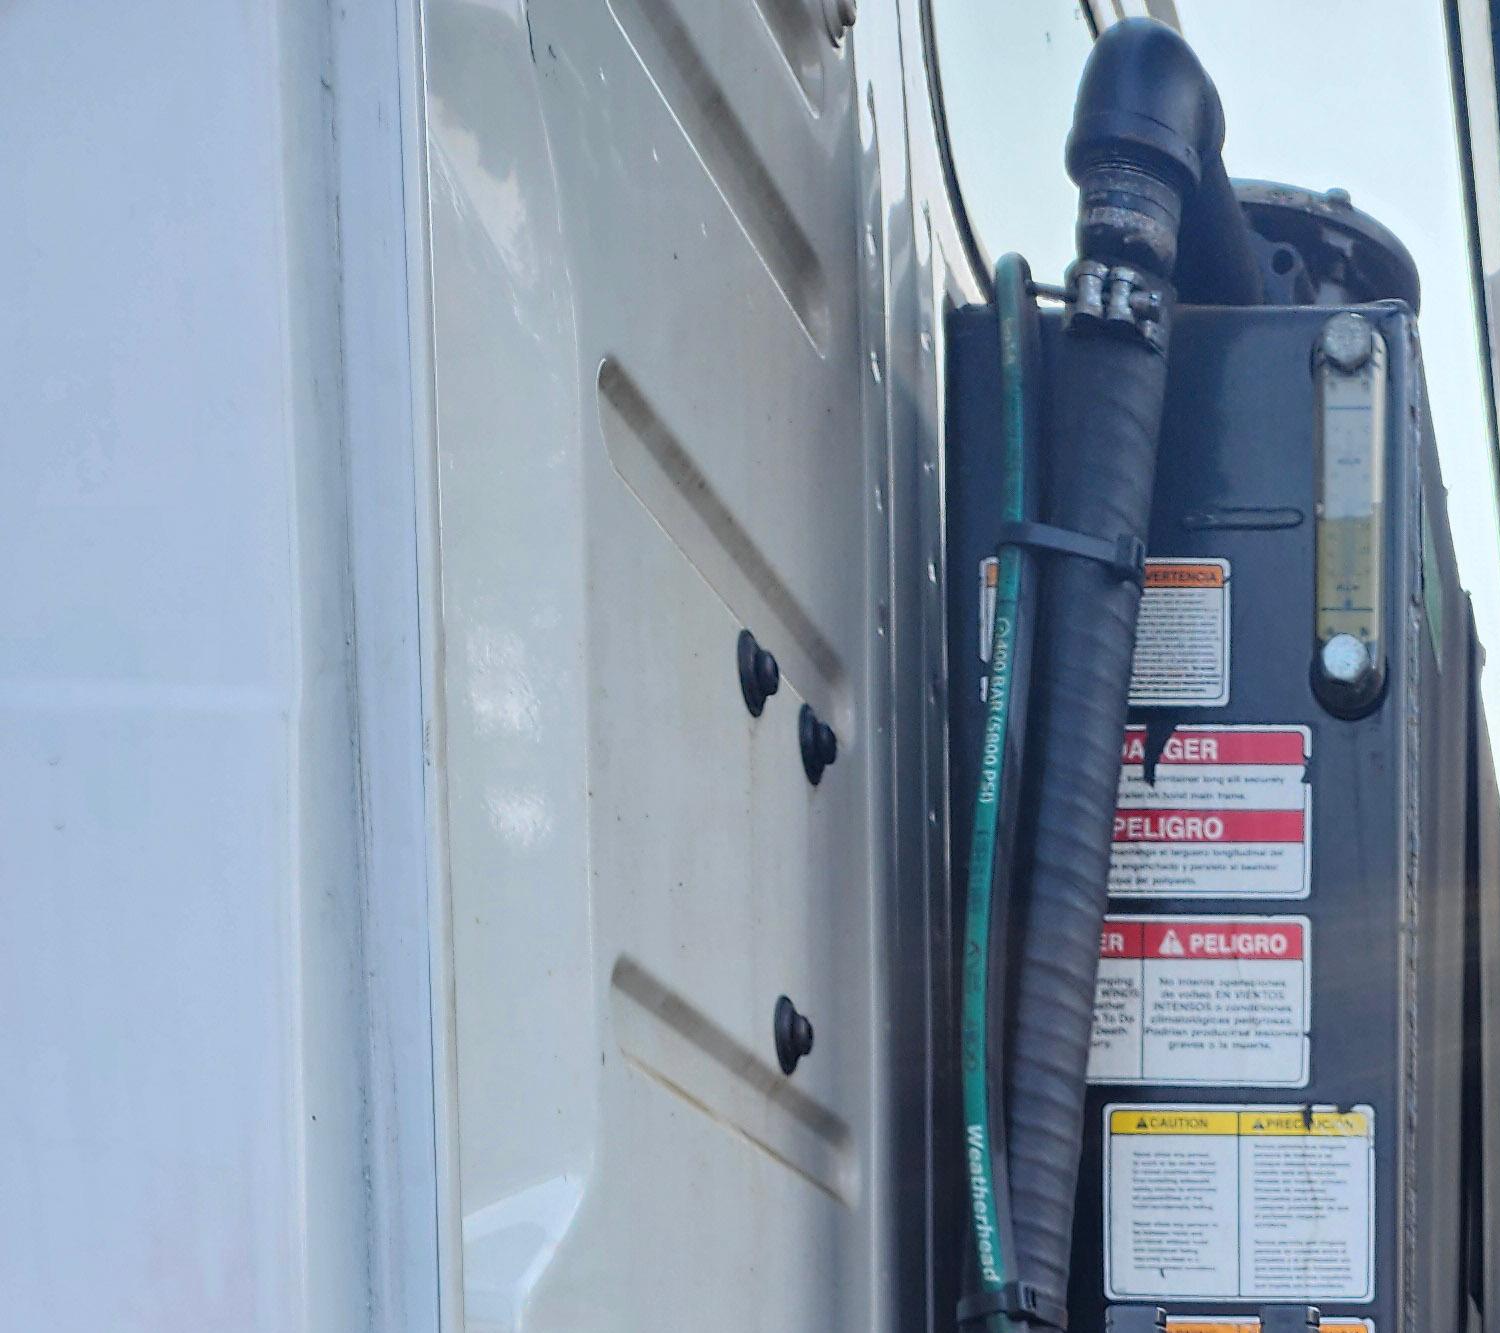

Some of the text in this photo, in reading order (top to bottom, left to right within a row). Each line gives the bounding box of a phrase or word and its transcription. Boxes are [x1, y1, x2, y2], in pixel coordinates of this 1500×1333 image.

[1122, 738, 1218, 761] AGER
[1113, 816, 1224, 840] PELIGRO
[1189, 934, 1287, 954] PELIGRO
[1150, 1116, 1209, 1129] CAUTION
[966, 1124, 1001, 1282] Weatherhead
